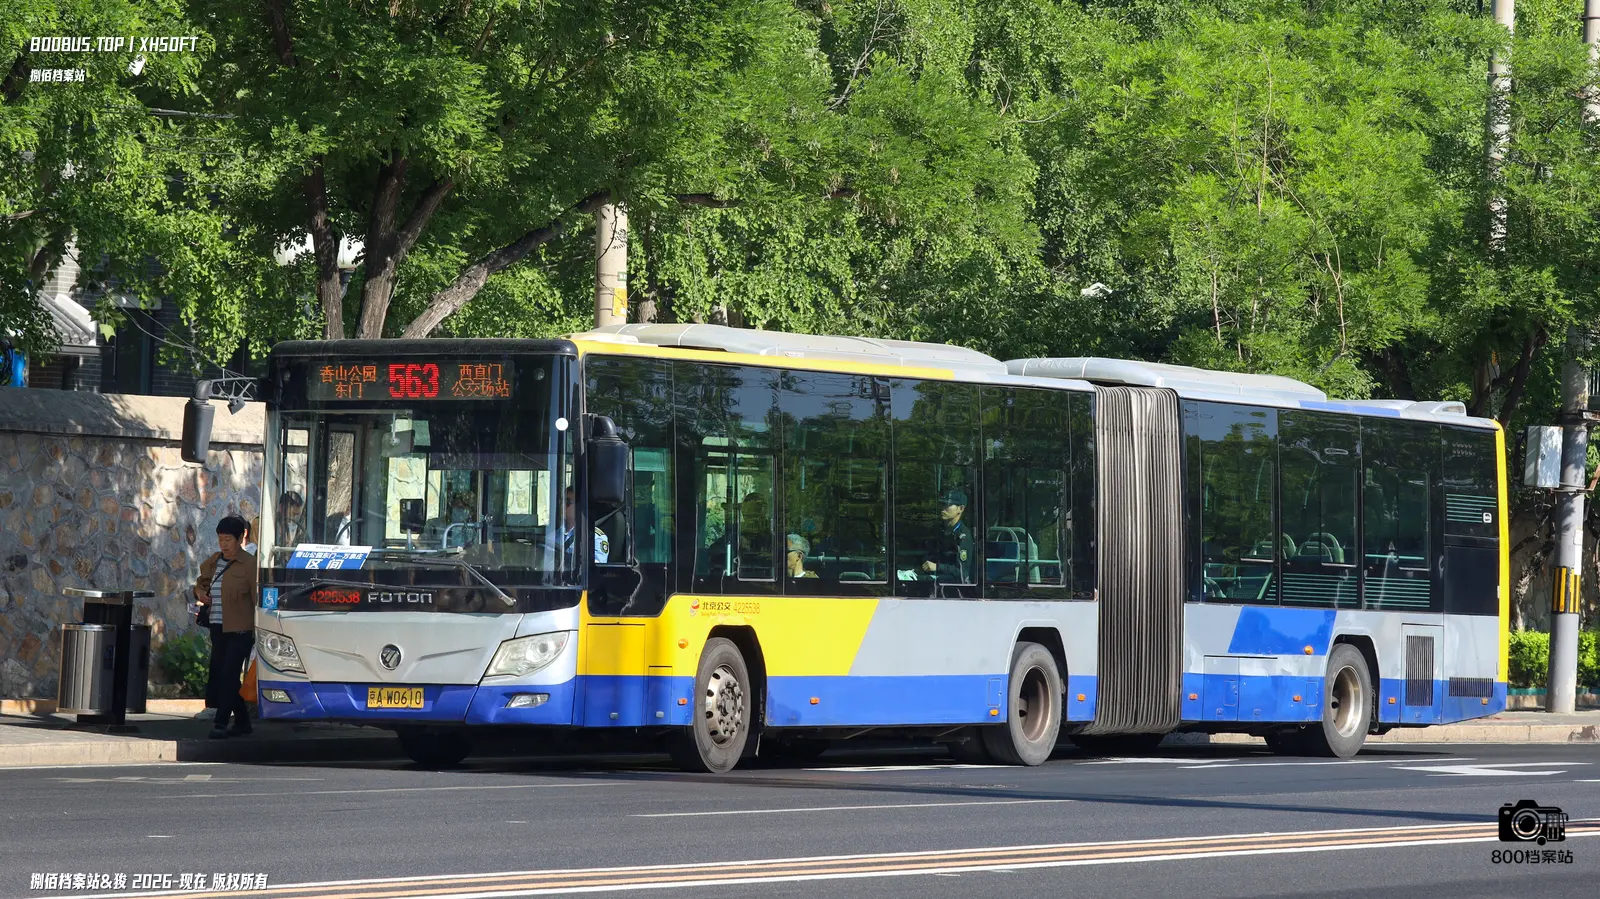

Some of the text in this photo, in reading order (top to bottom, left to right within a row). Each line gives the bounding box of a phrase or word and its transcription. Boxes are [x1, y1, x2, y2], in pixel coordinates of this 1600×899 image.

[319, 365, 377, 383] 香山公园
[388, 364, 439, 398] 563
[459, 364, 504, 381] 西直门
[335, 382, 363, 399] 东门
[451, 379, 510, 397] 公交场站
[310, 590, 361, 604] 4225538
[367, 592, 433, 604] FOTON
[702, 601, 731, 611] 北京公交
[733, 602, 760, 614] 4225538
